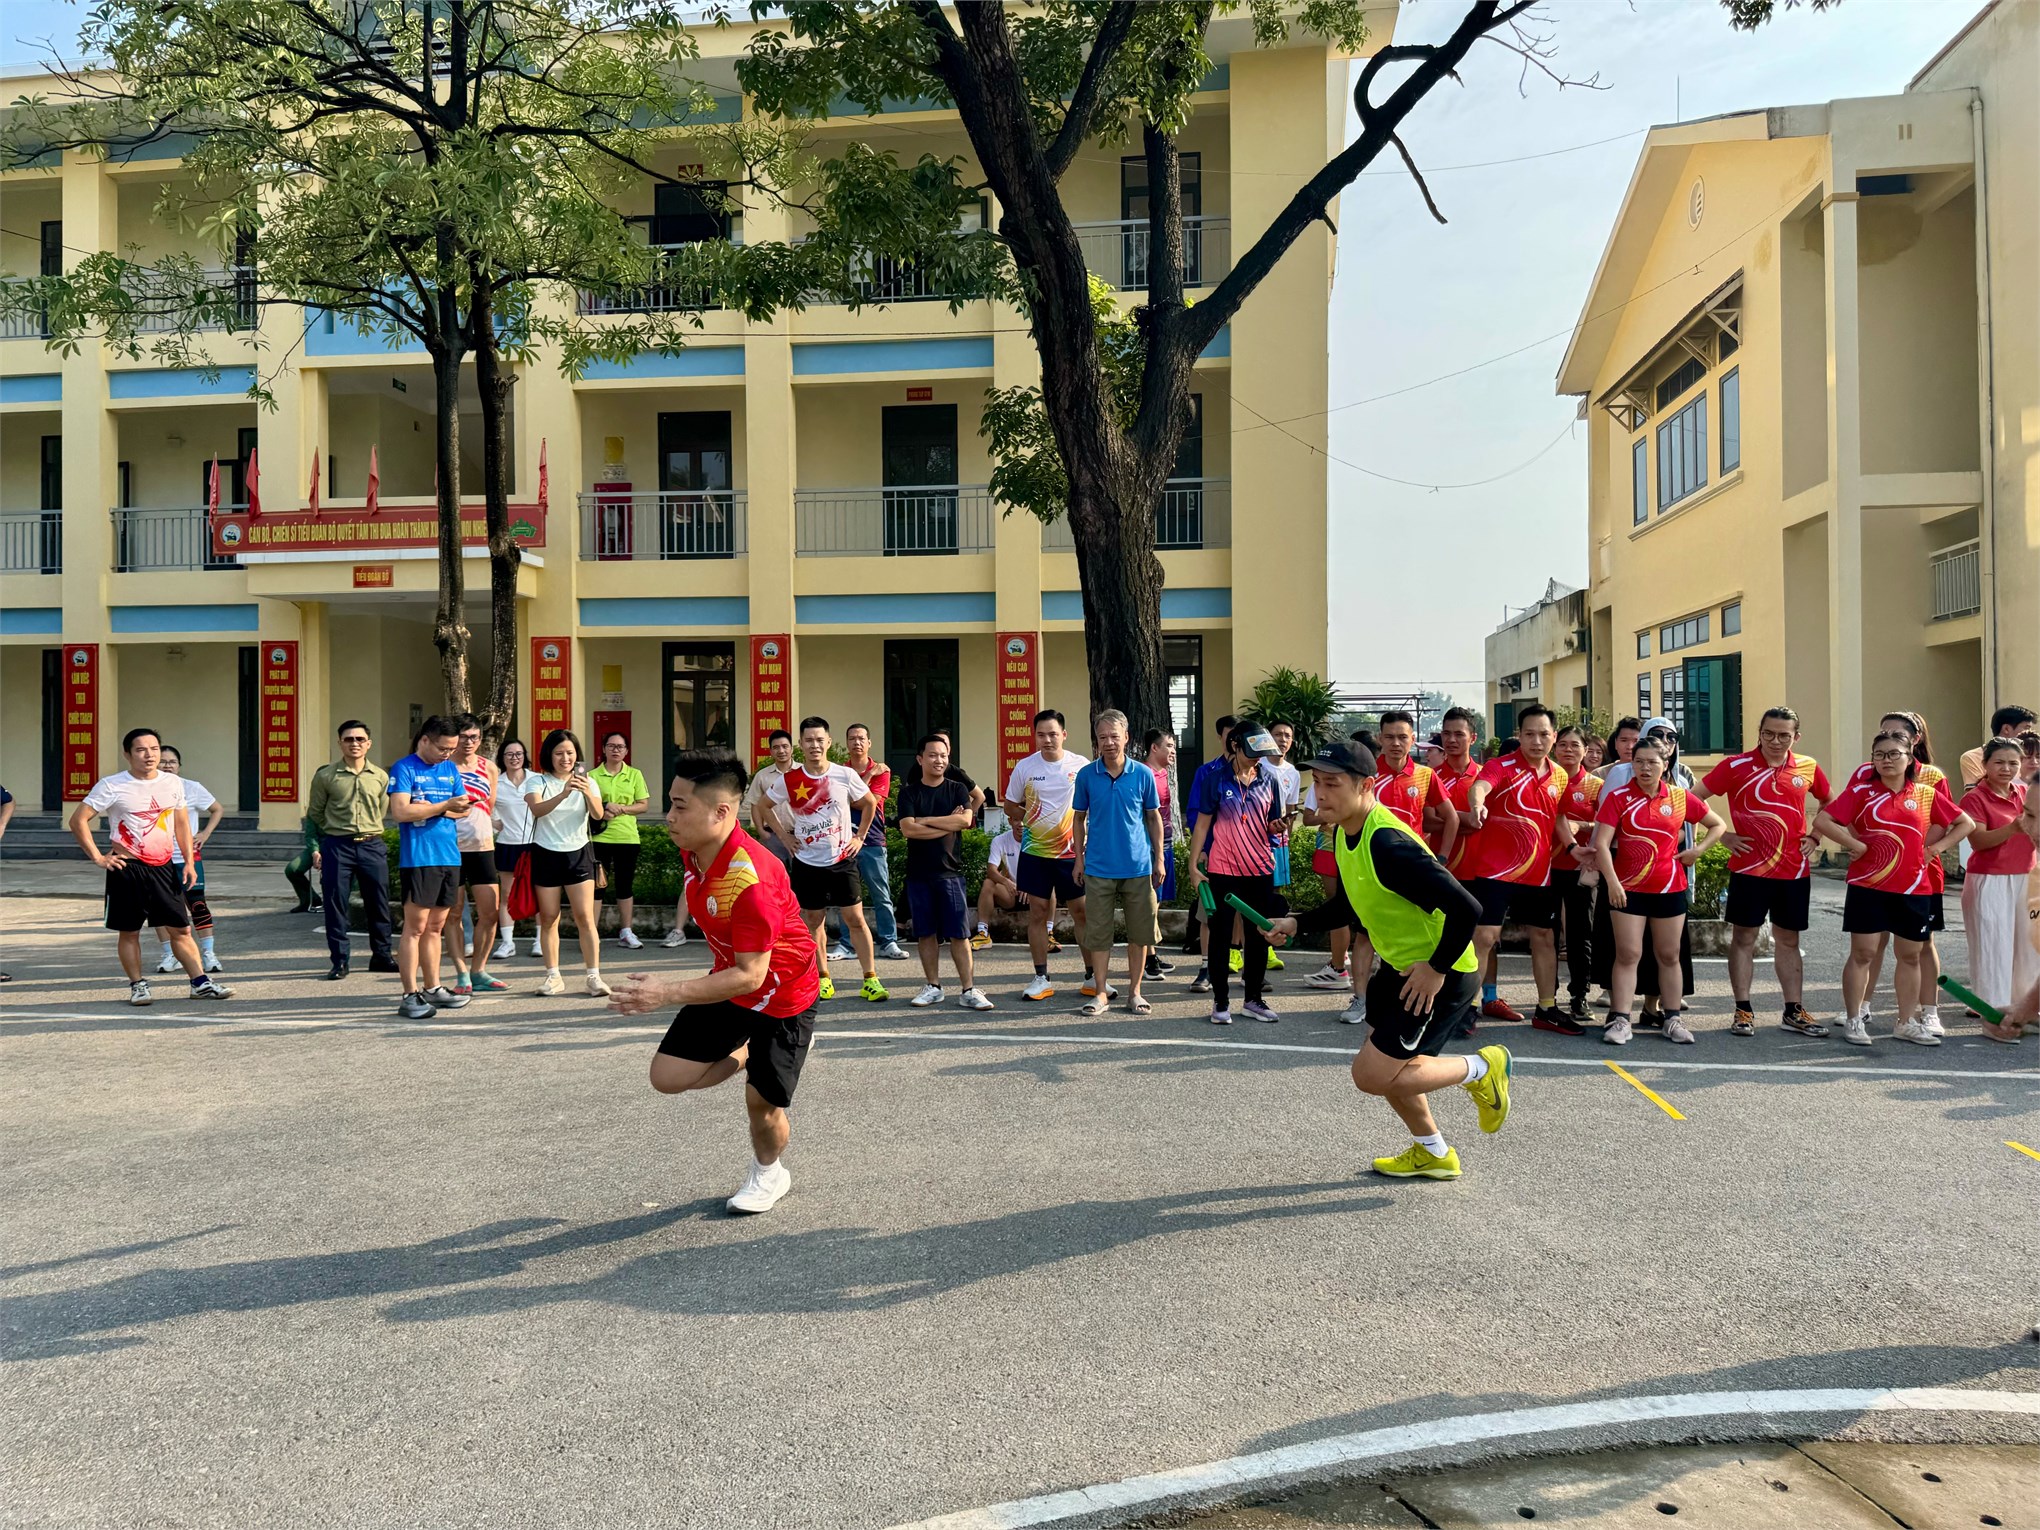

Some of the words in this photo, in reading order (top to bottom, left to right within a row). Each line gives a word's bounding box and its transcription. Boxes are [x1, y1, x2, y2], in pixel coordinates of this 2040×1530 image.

[1018, 662, 1028, 672] CAO
[1001, 693, 1017, 704] TRÁCH
[1010, 708, 1026, 720] CHỐNG
